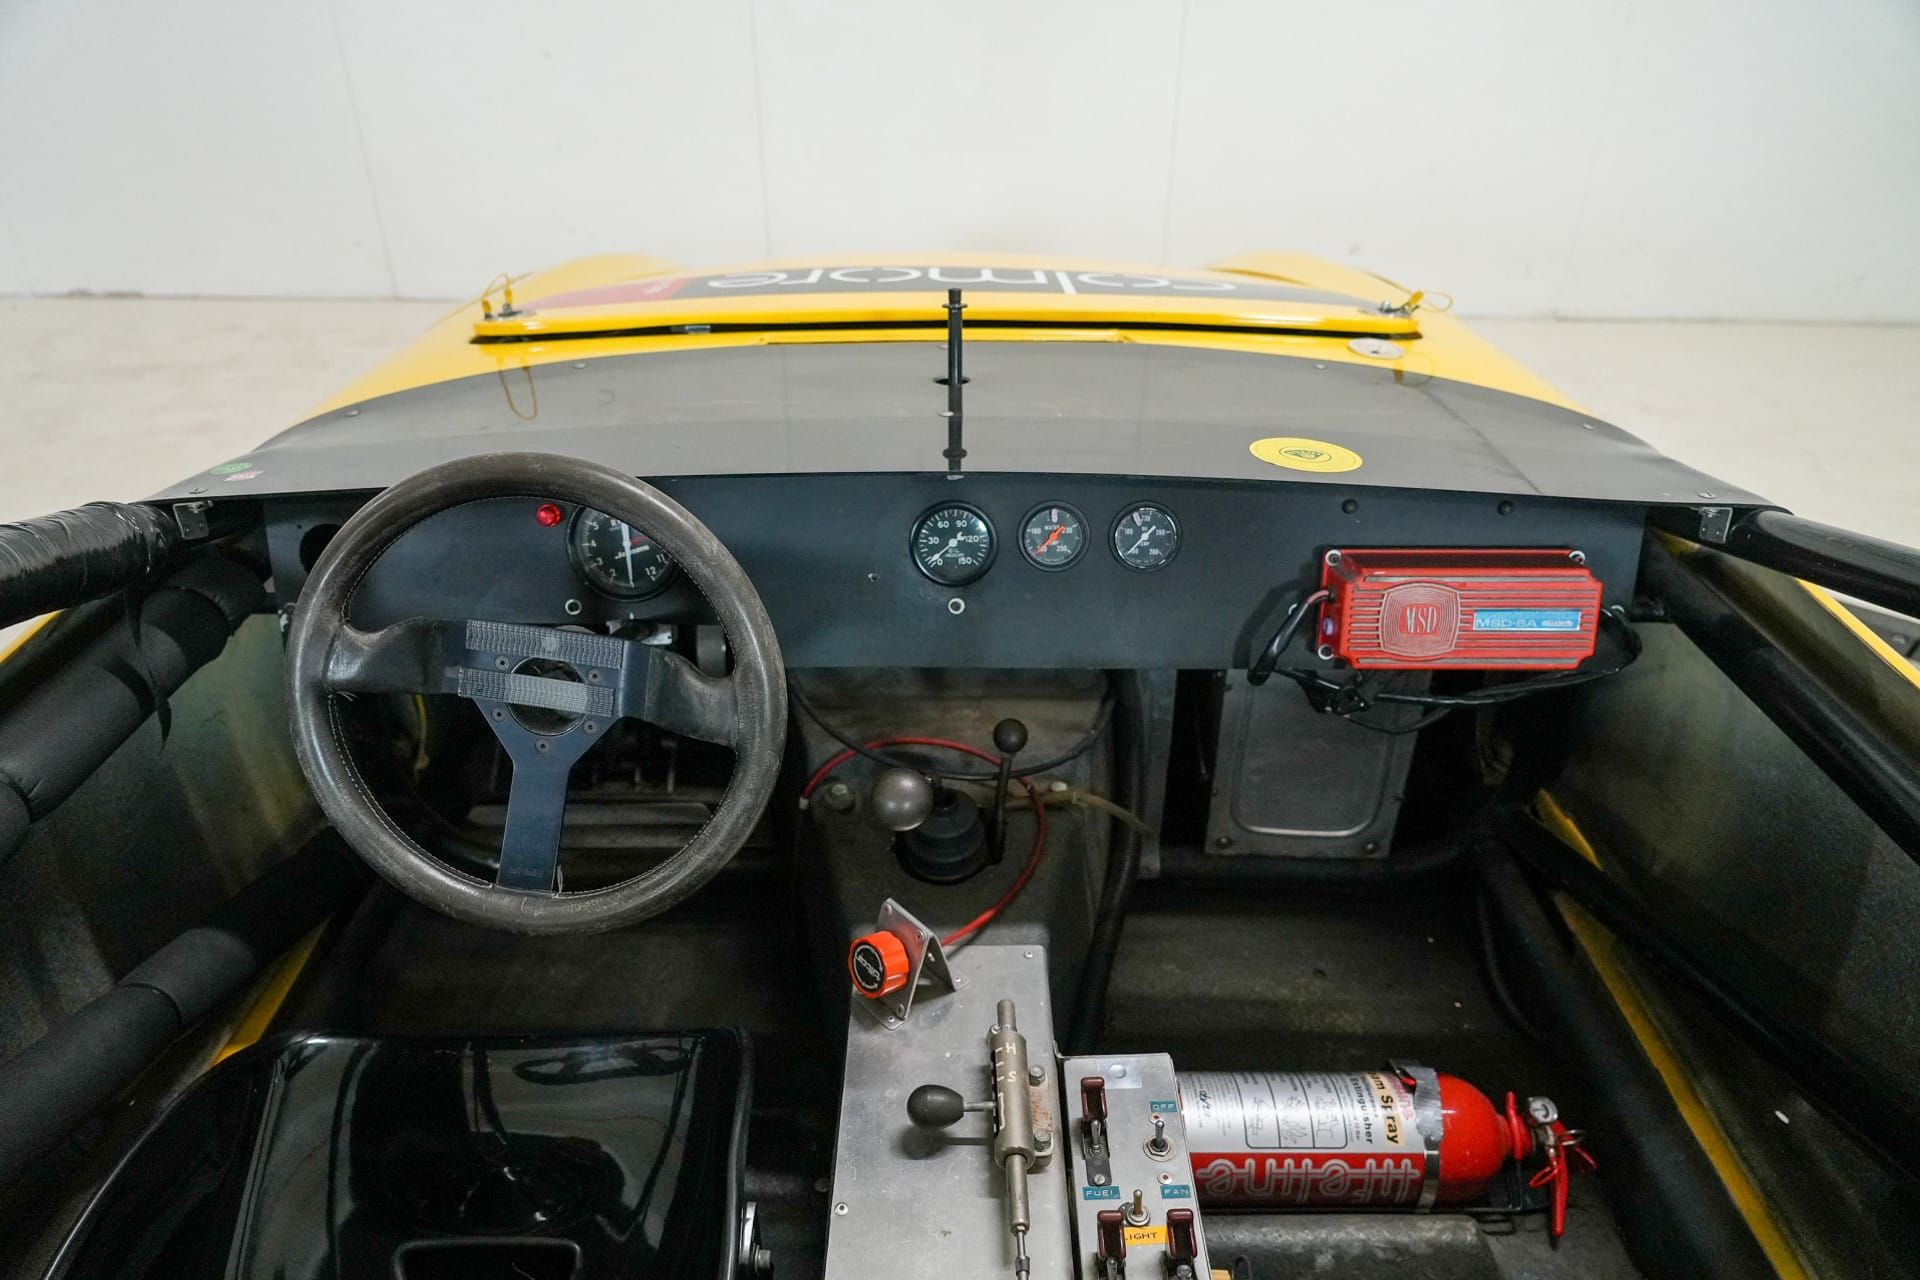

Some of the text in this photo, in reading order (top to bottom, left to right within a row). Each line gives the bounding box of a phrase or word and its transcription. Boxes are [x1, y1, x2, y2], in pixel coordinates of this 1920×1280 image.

[705, 267, 1237, 294] colmore
[592, 522, 600, 530] 5
[956, 520, 967, 528] 90
[590, 539, 597, 547] 4
[964, 535, 979, 543] 120
[596, 557, 603, 566] 3
[936, 558, 943, 566] 0
[609, 569, 617, 577] 2
[645, 566, 657, 576] 12
[1406, 607, 1438, 633] MSD
[1005, 1042, 1017, 1055] H
[1007, 1070, 1017, 1083] S
[1086, 1189, 1119, 1199] FUEL
[1164, 1188, 1190, 1197] FAN
